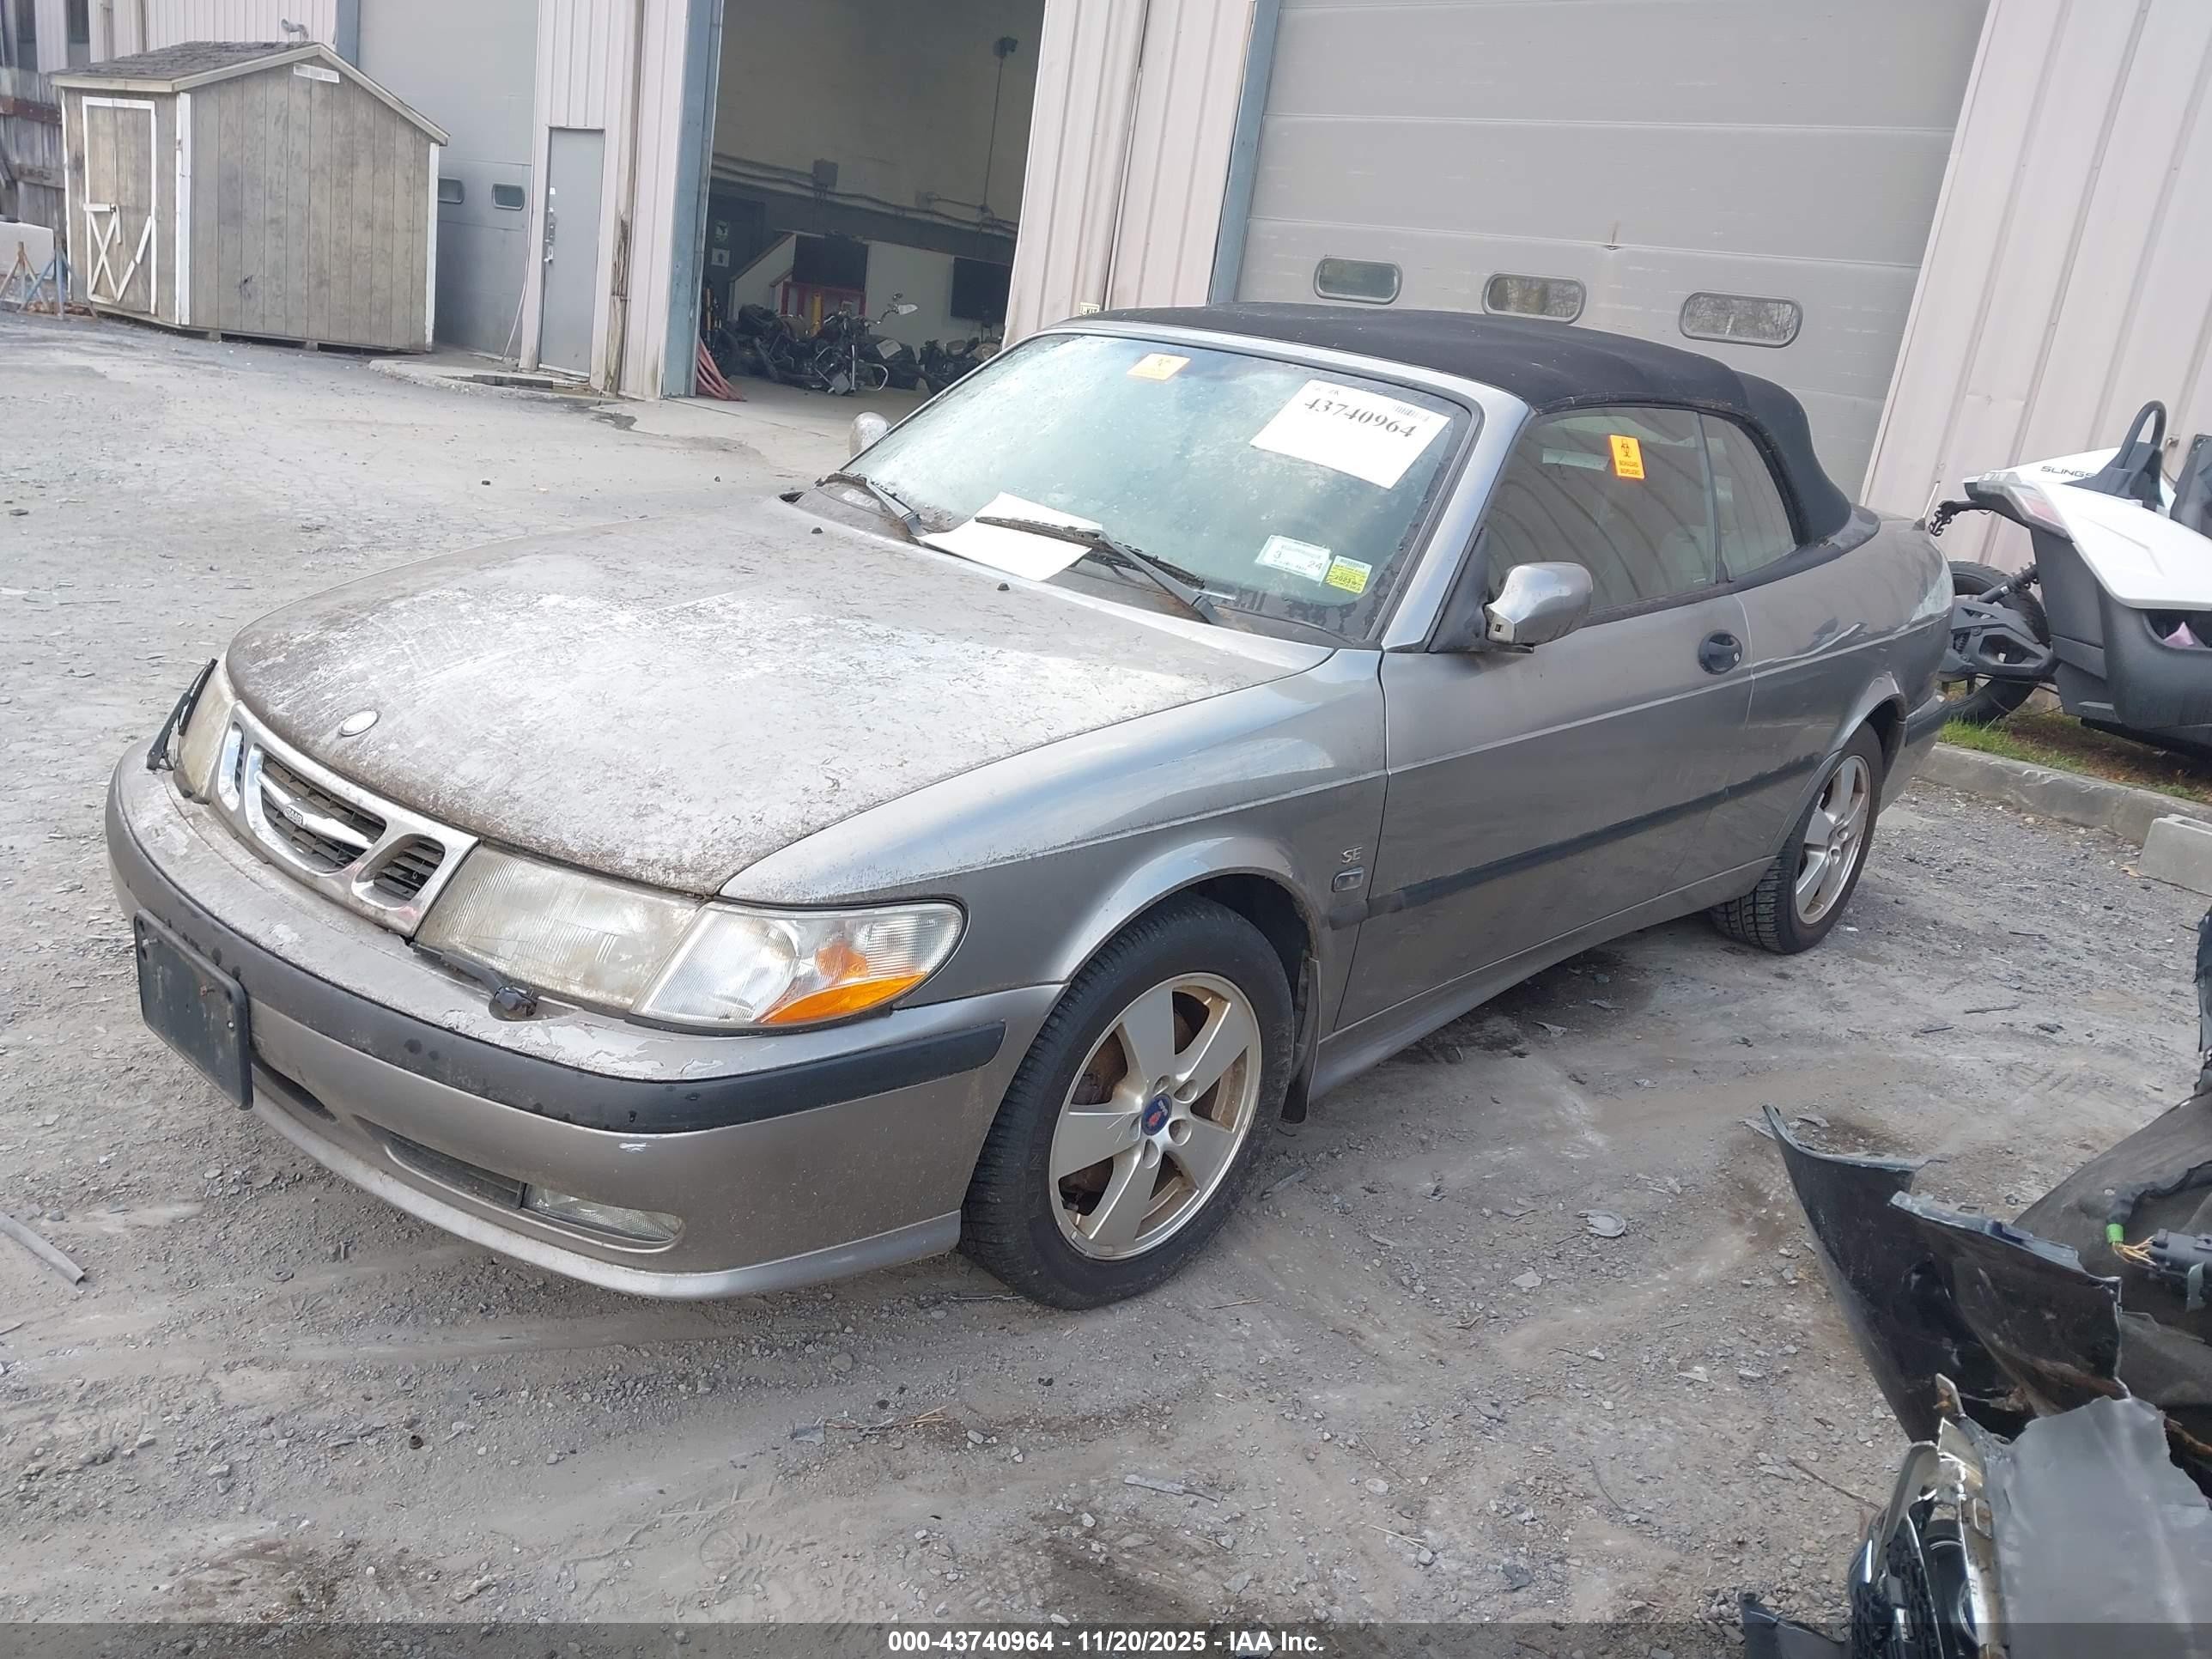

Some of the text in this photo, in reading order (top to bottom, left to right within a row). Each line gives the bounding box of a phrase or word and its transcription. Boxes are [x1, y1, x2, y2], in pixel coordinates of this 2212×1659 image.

[1304, 398, 1418, 438] 43740964
[283, 807, 303, 826] SAAB
[1341, 845, 1363, 864] SE
